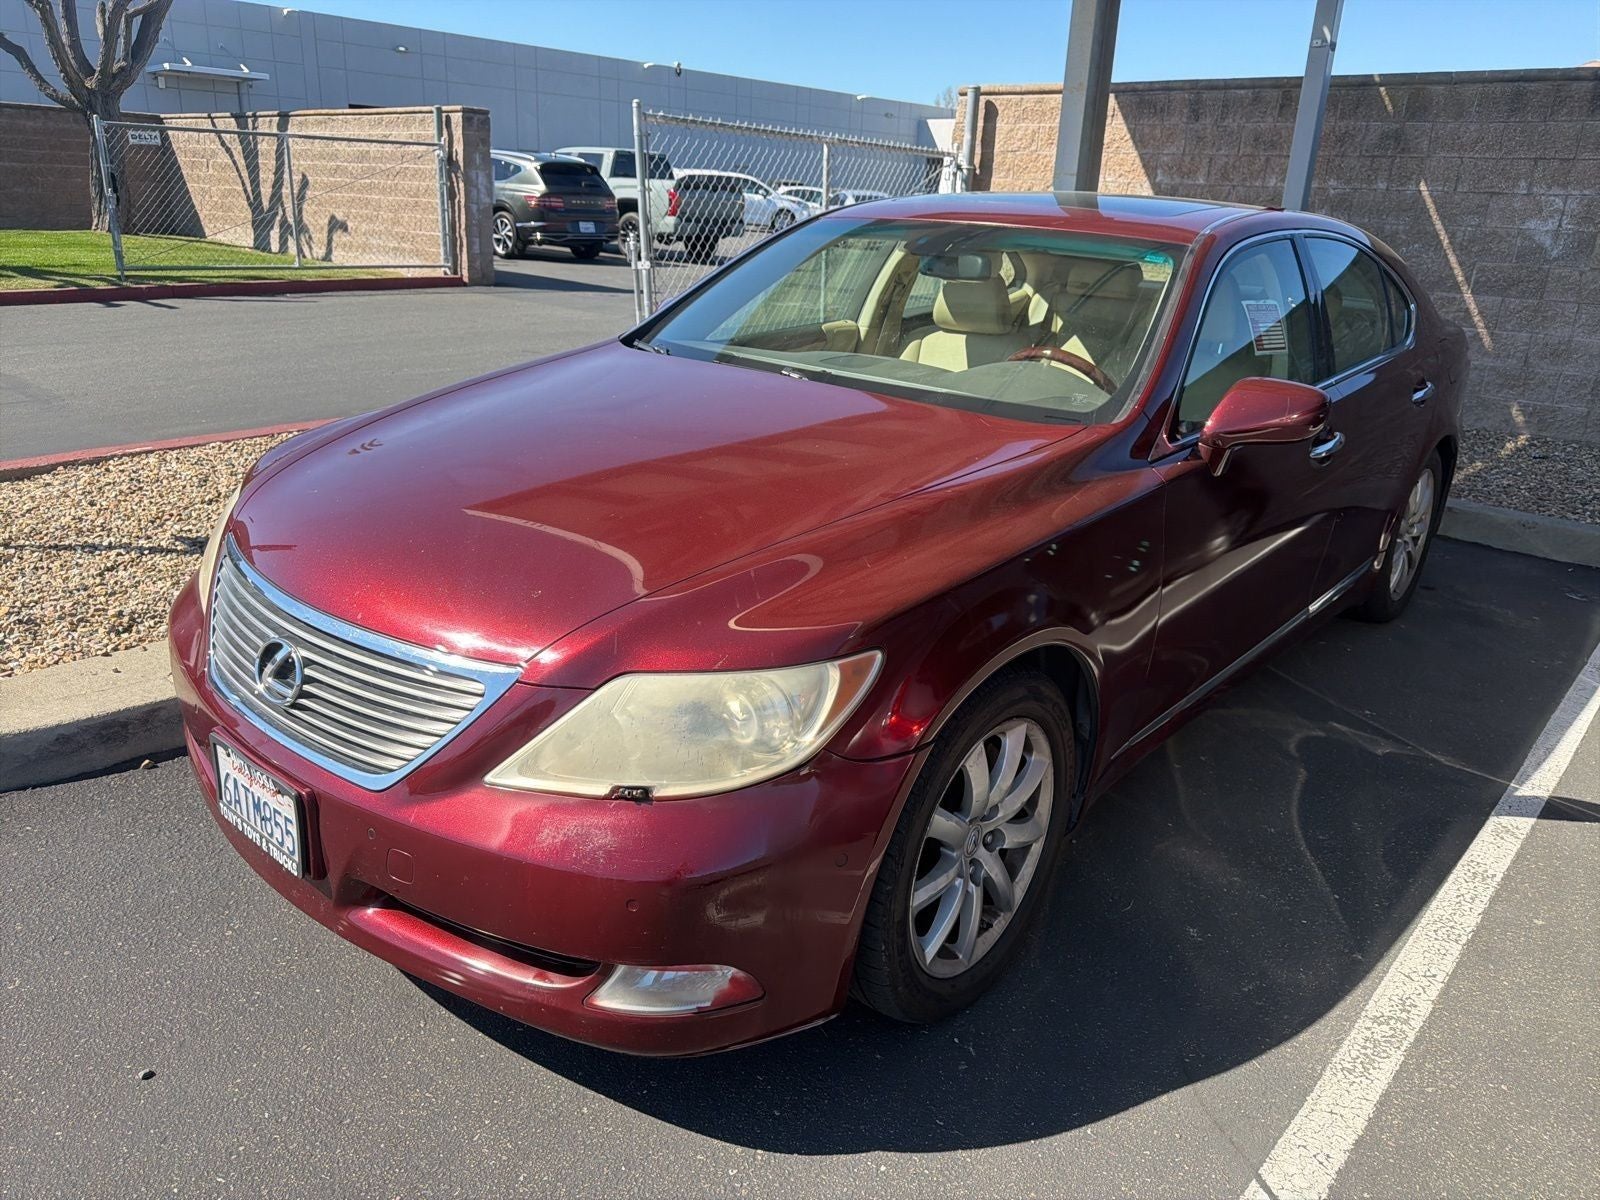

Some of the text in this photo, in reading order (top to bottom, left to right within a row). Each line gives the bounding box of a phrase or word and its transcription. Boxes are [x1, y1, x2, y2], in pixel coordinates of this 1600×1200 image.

[223, 771, 296, 857] 6ATM855
[242, 822, 261, 847] TOYS
[262, 838, 268, 853] &
[268, 842, 298, 876] TRUCKS
